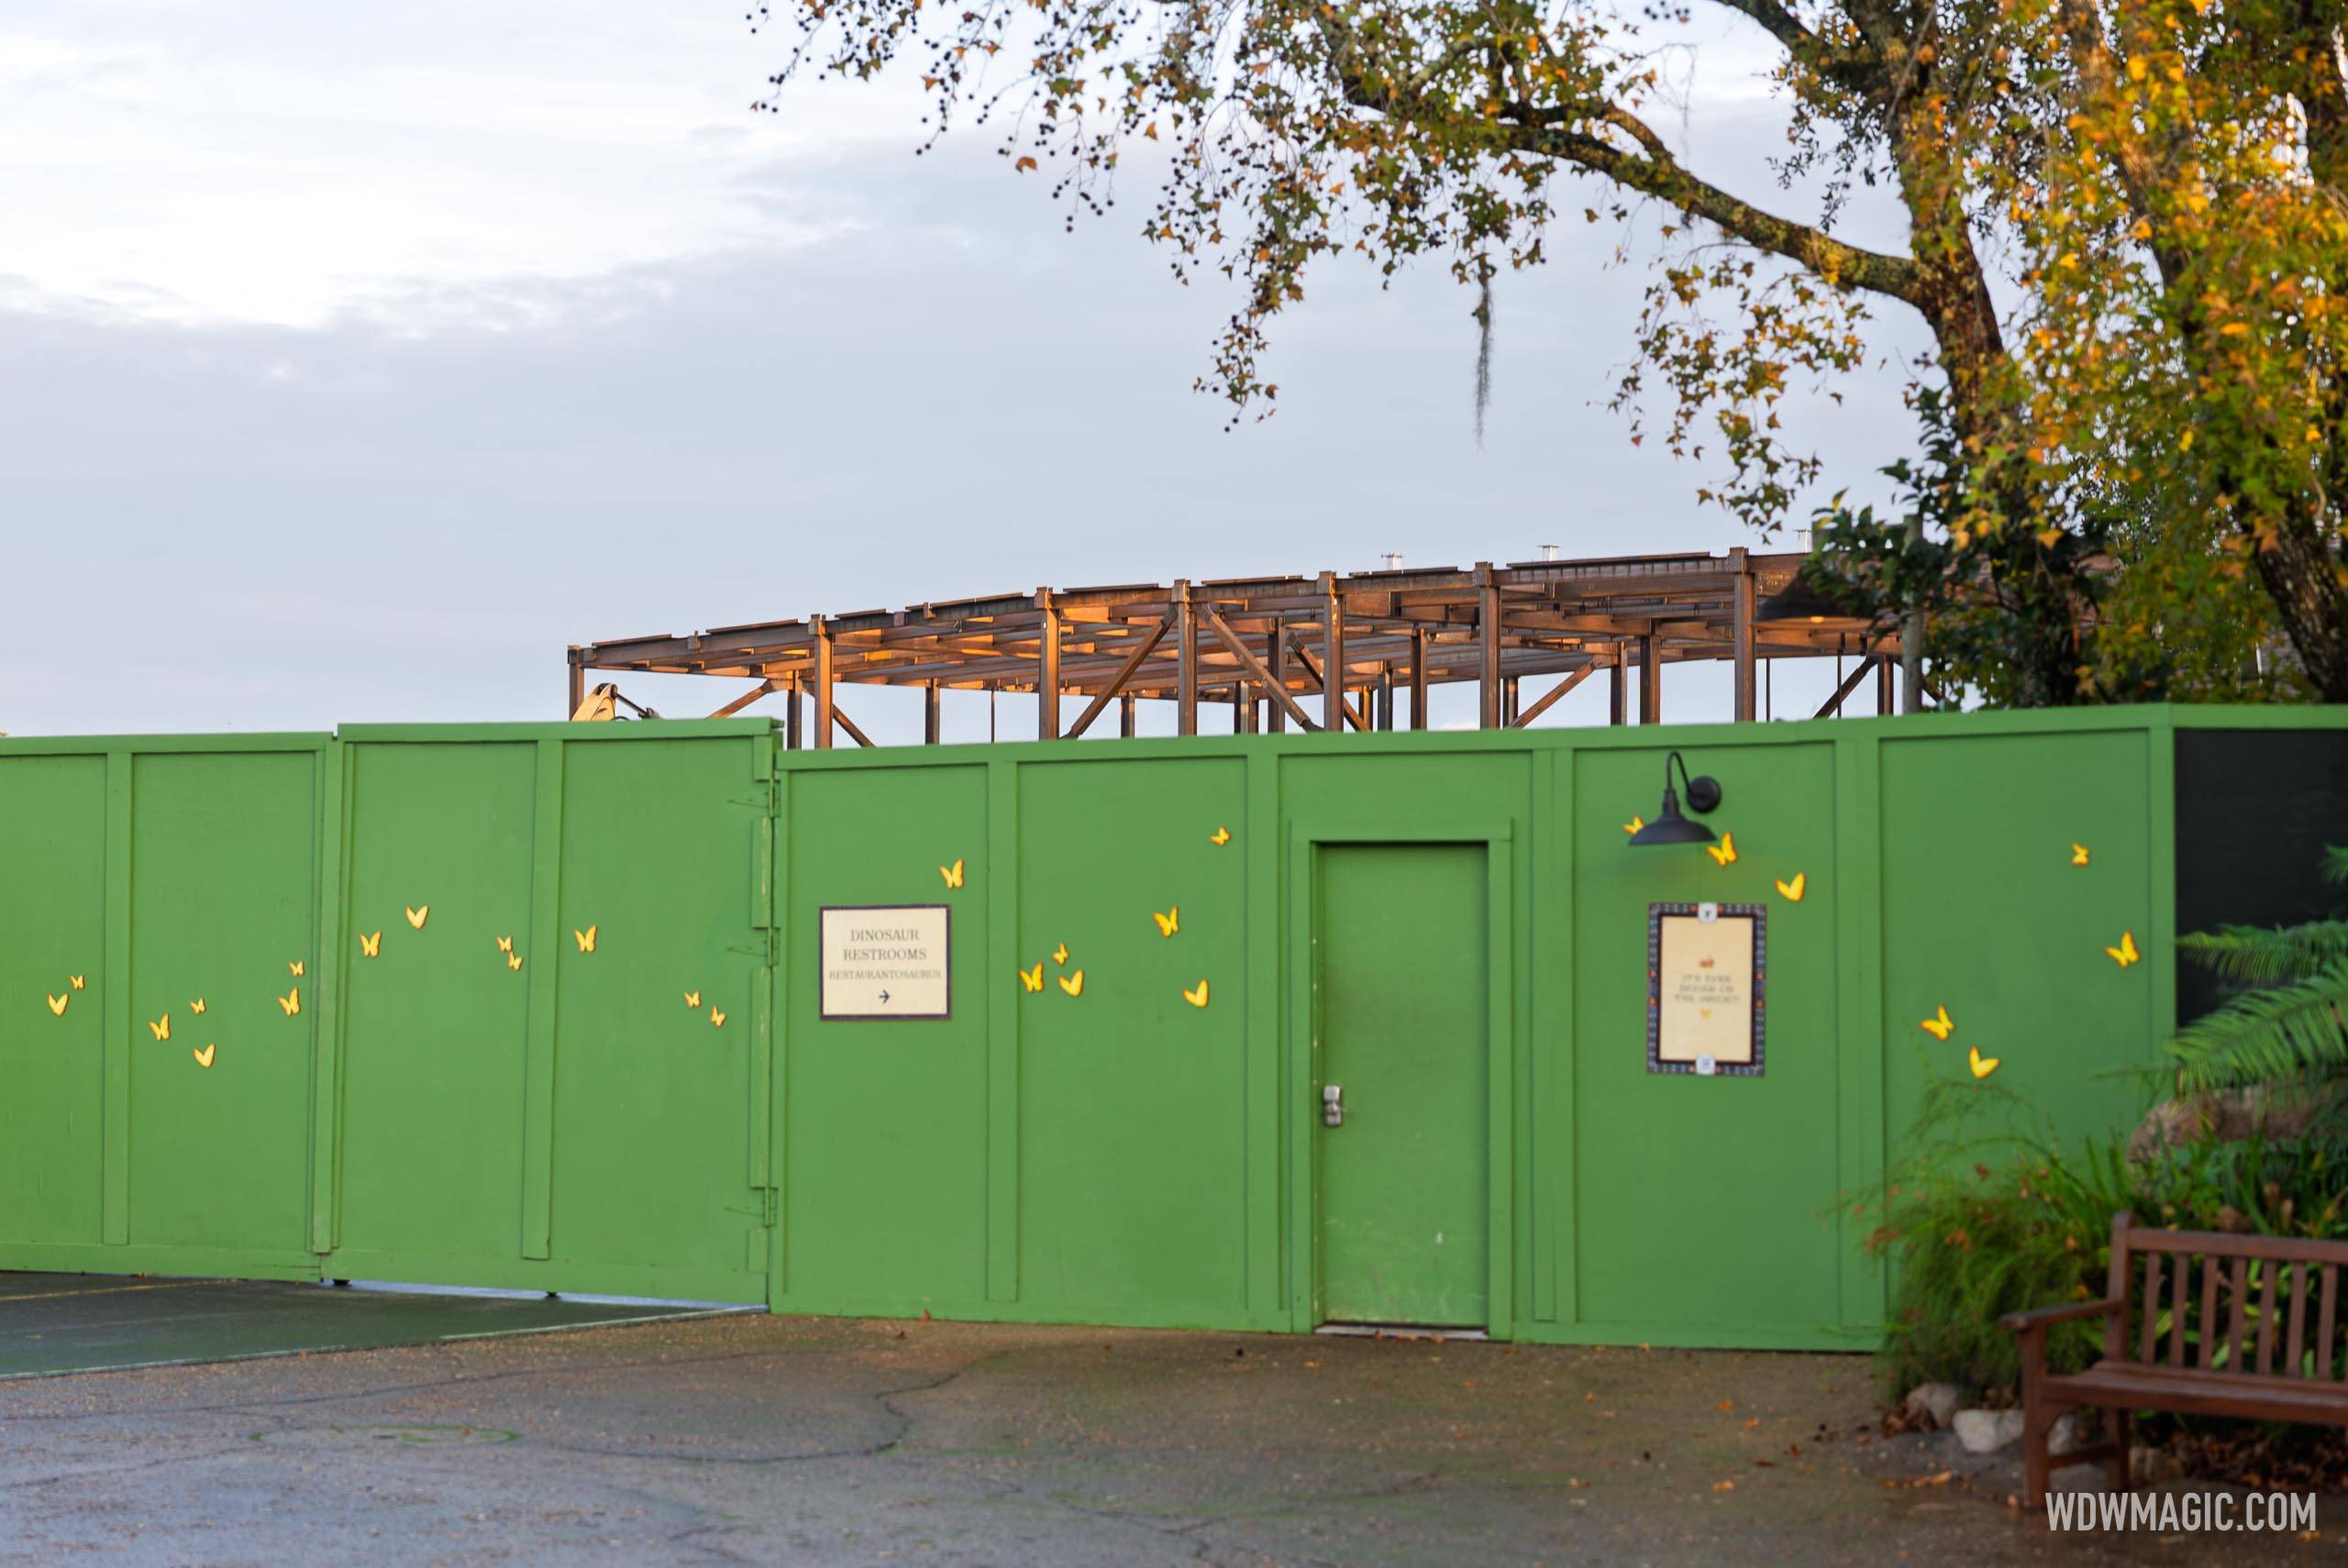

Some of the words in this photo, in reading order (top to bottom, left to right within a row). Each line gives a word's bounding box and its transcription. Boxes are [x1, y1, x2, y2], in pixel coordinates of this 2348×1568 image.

[850, 929, 920, 942] DINOSAUR
[844, 948, 927, 961] RESTROOMS
[829, 969, 942, 980] RESTAURANTOSAURUS
